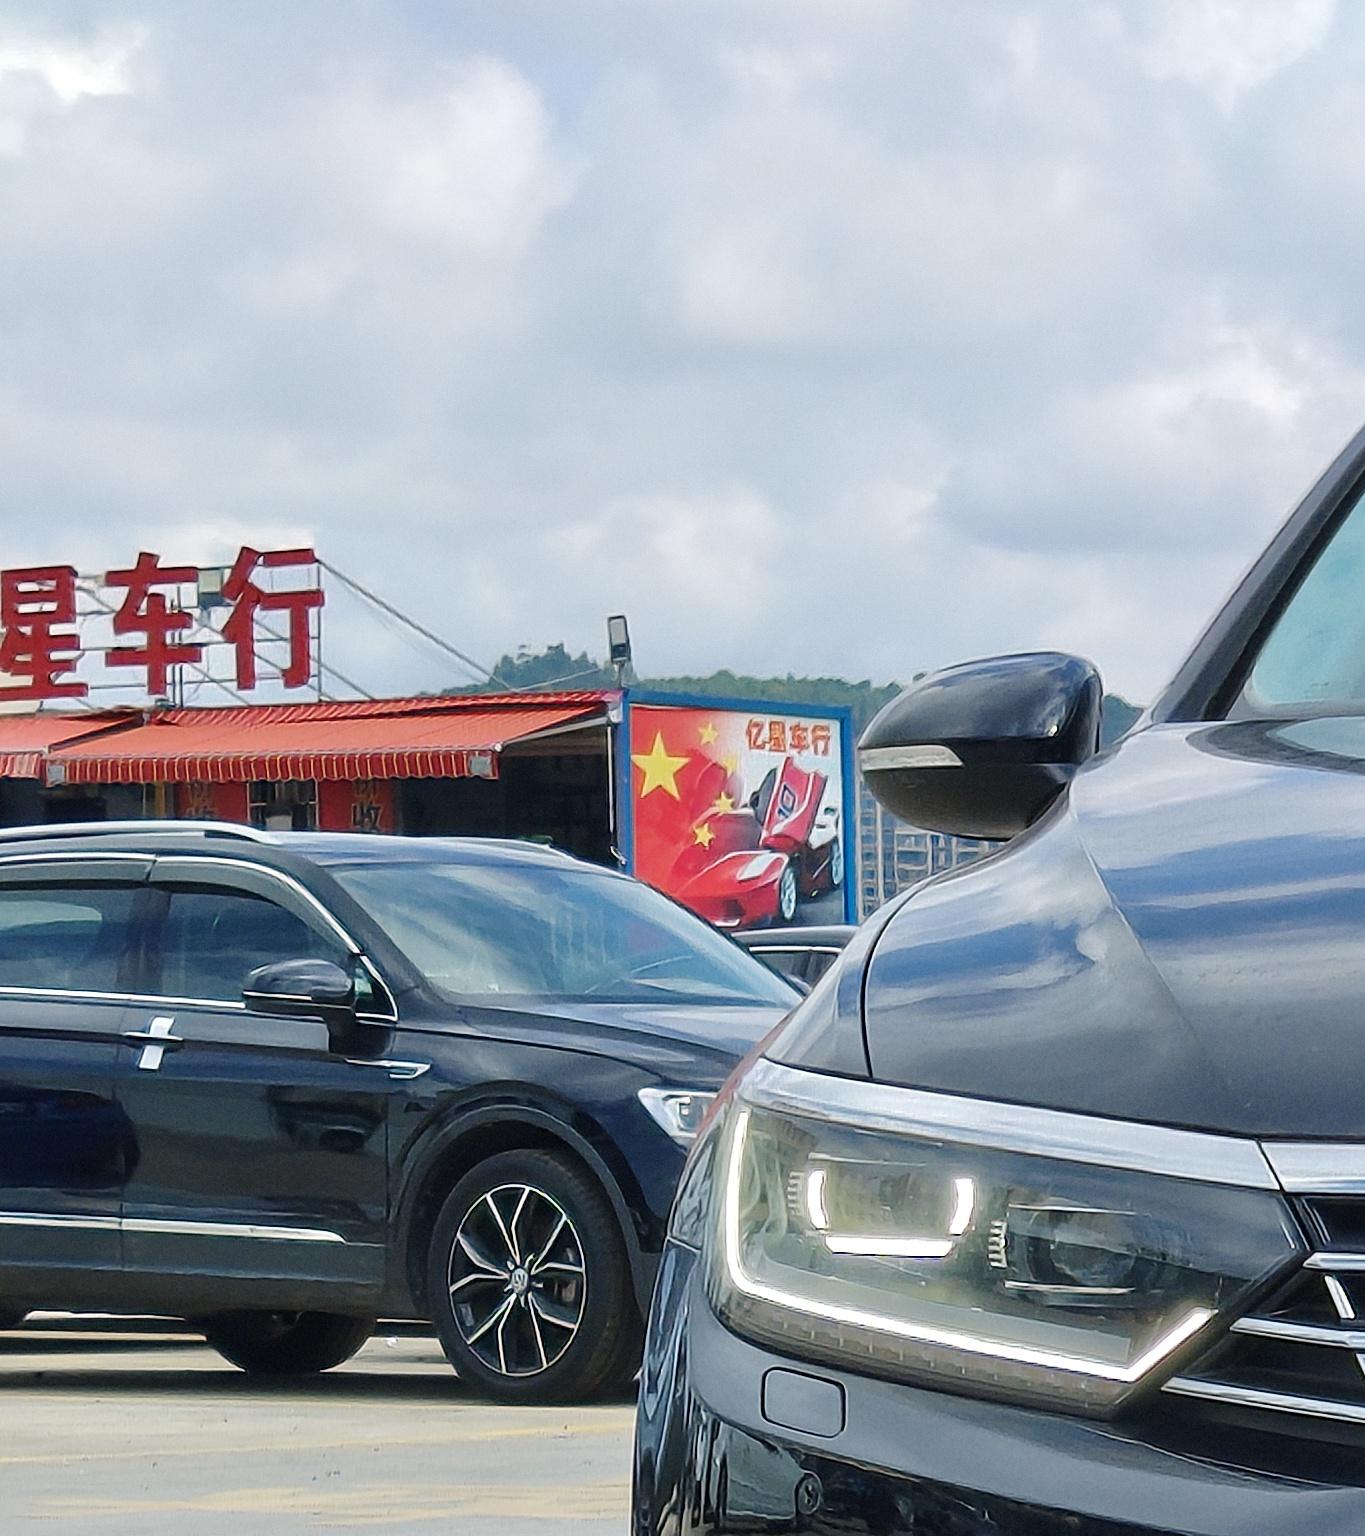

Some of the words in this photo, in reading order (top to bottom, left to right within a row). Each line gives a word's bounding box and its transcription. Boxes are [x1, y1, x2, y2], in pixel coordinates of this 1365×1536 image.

[0, 547, 325, 697] 星车行
[746, 719, 831, 755] 亿星车行
